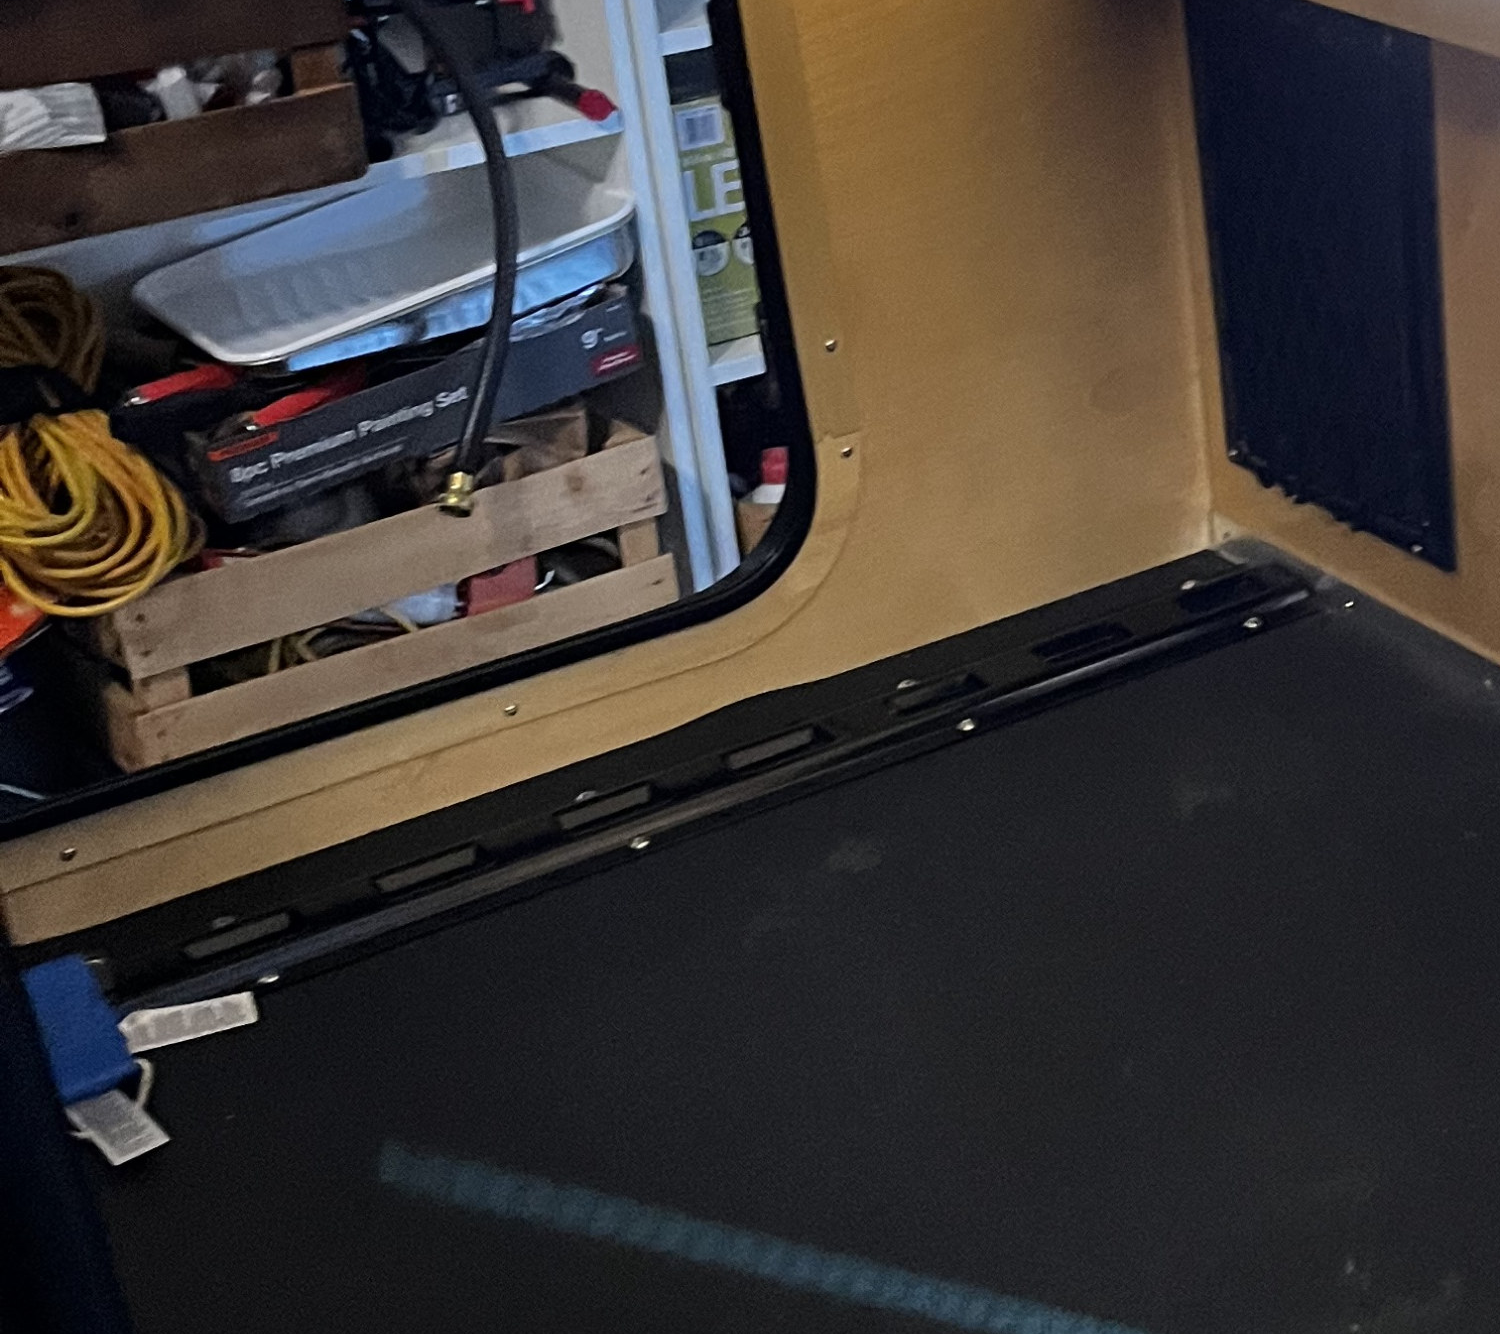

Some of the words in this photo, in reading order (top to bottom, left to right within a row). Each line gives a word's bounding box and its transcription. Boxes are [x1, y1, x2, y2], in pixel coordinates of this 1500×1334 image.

[269, 429, 357, 469] Premium
[357, 400, 434, 437] Painting
[435, 386, 469, 408] Set
